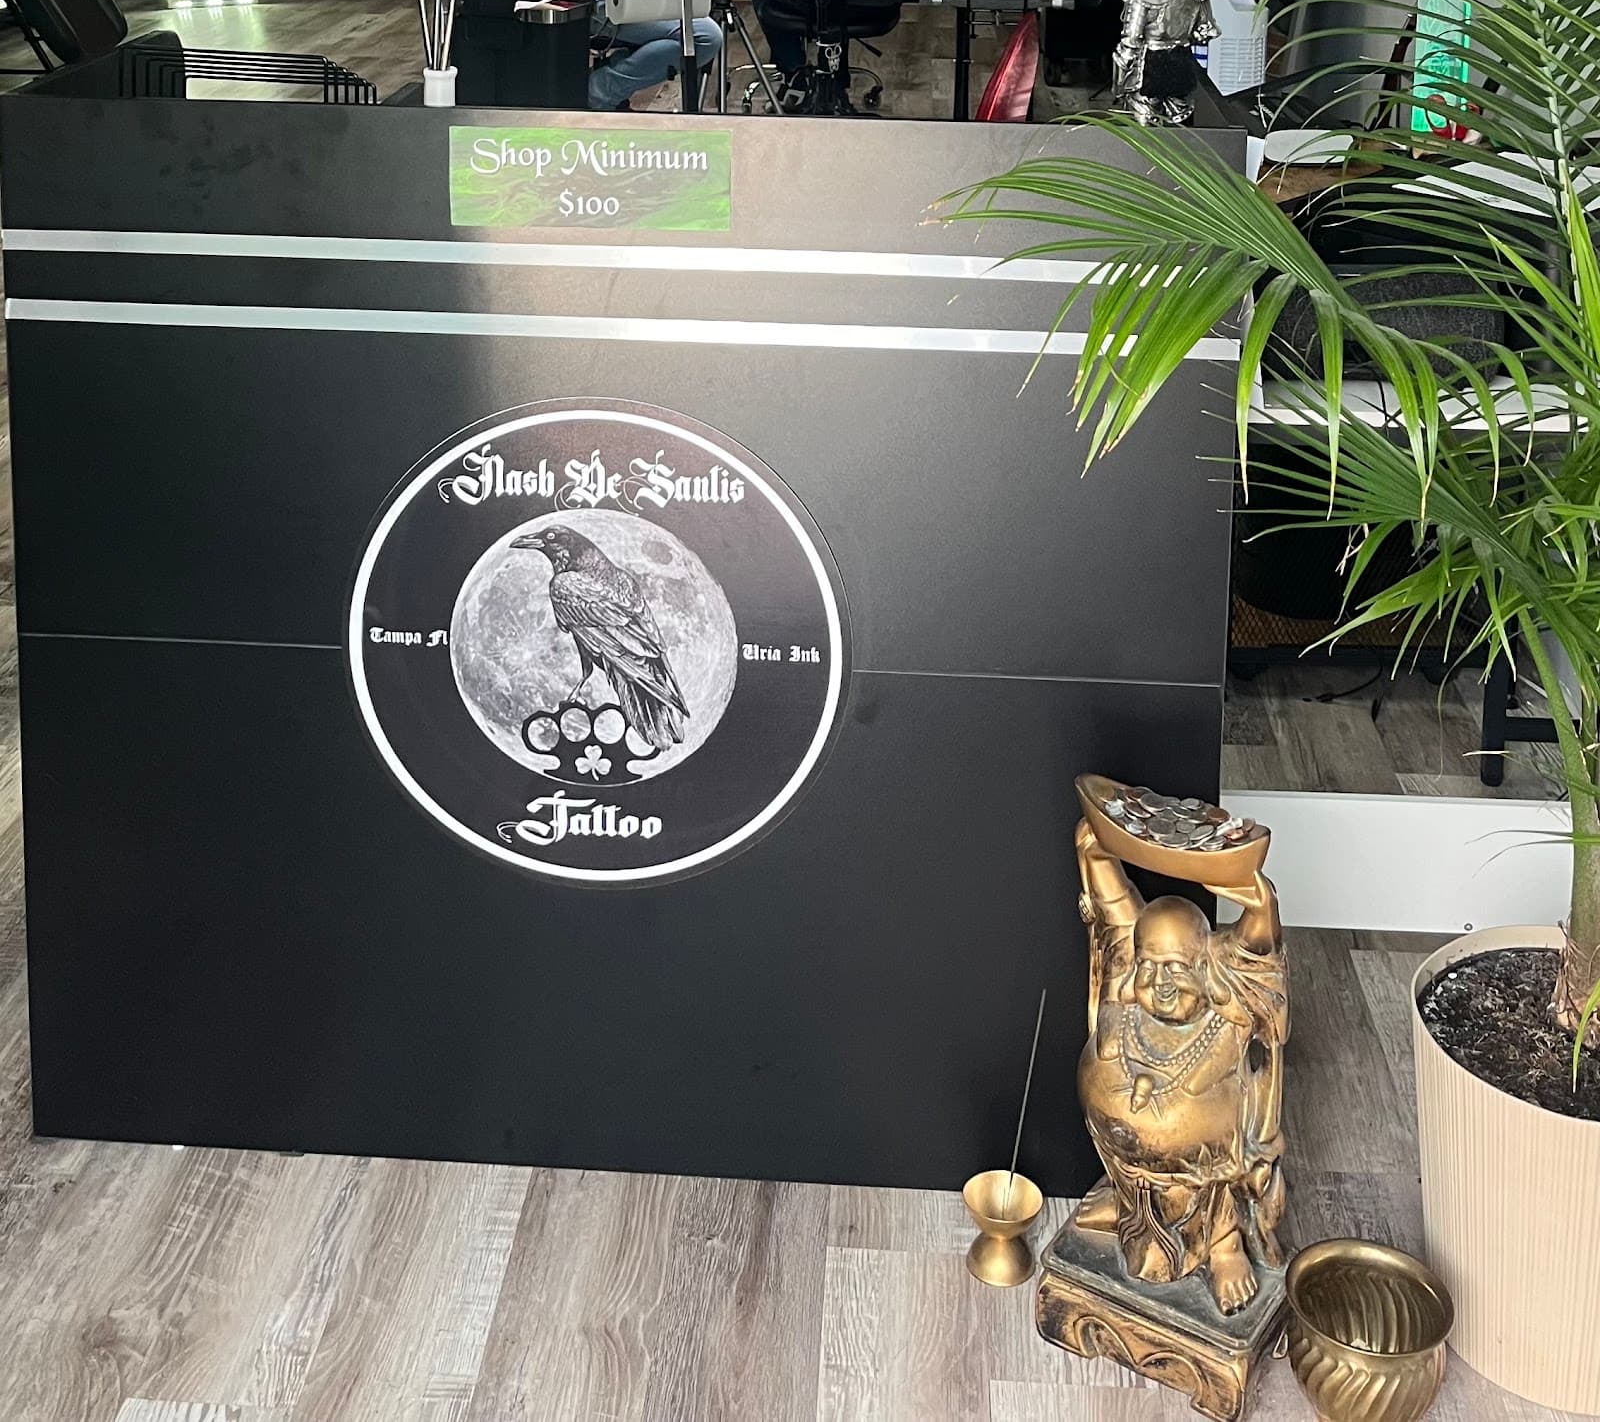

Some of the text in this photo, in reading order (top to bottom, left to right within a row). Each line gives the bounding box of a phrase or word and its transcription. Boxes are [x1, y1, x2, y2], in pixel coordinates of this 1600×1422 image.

[470, 138, 709, 178] Shop Minimum
[559, 188, 620, 217] $100
[437, 444, 745, 514] Nash De Santis
[369, 626, 422, 646] Tampa
[788, 645, 820, 663] Ink
[496, 790, 662, 846] Tattoo
